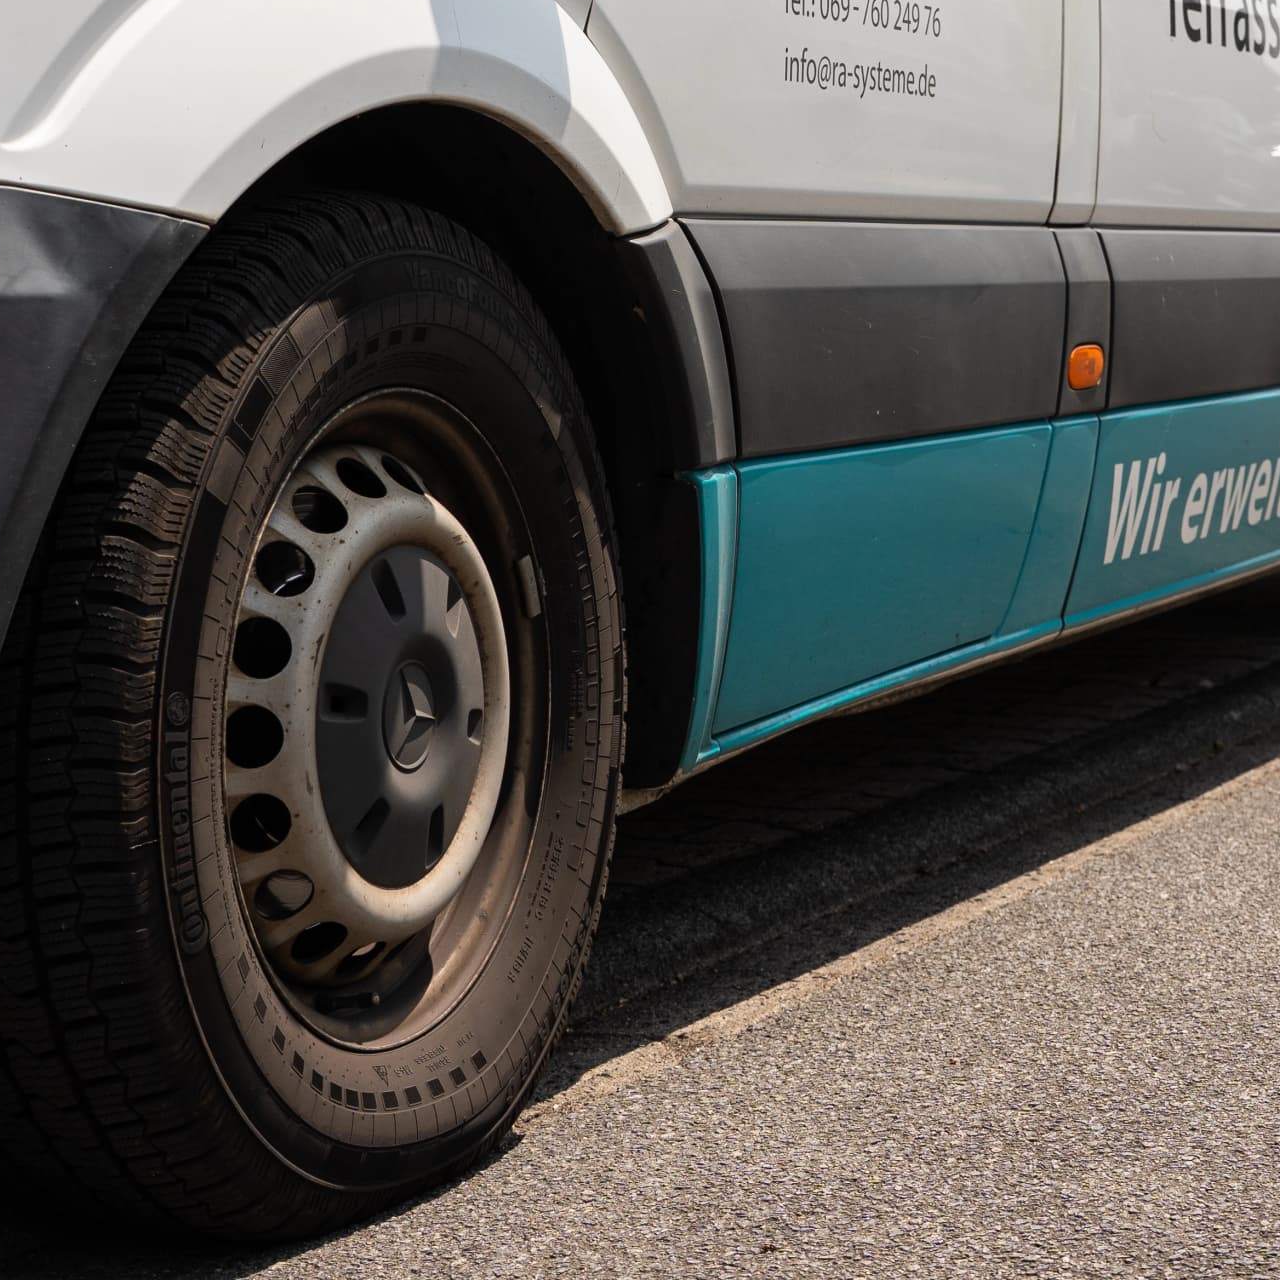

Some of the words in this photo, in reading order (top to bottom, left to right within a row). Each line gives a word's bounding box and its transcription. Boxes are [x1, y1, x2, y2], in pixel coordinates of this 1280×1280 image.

[893, 0, 920, 35] 249
[924, 5, 942, 38] 76
[784, 48, 938, 100] info@ra-systeme.de
[1102, 451, 1182, 566] Wir
